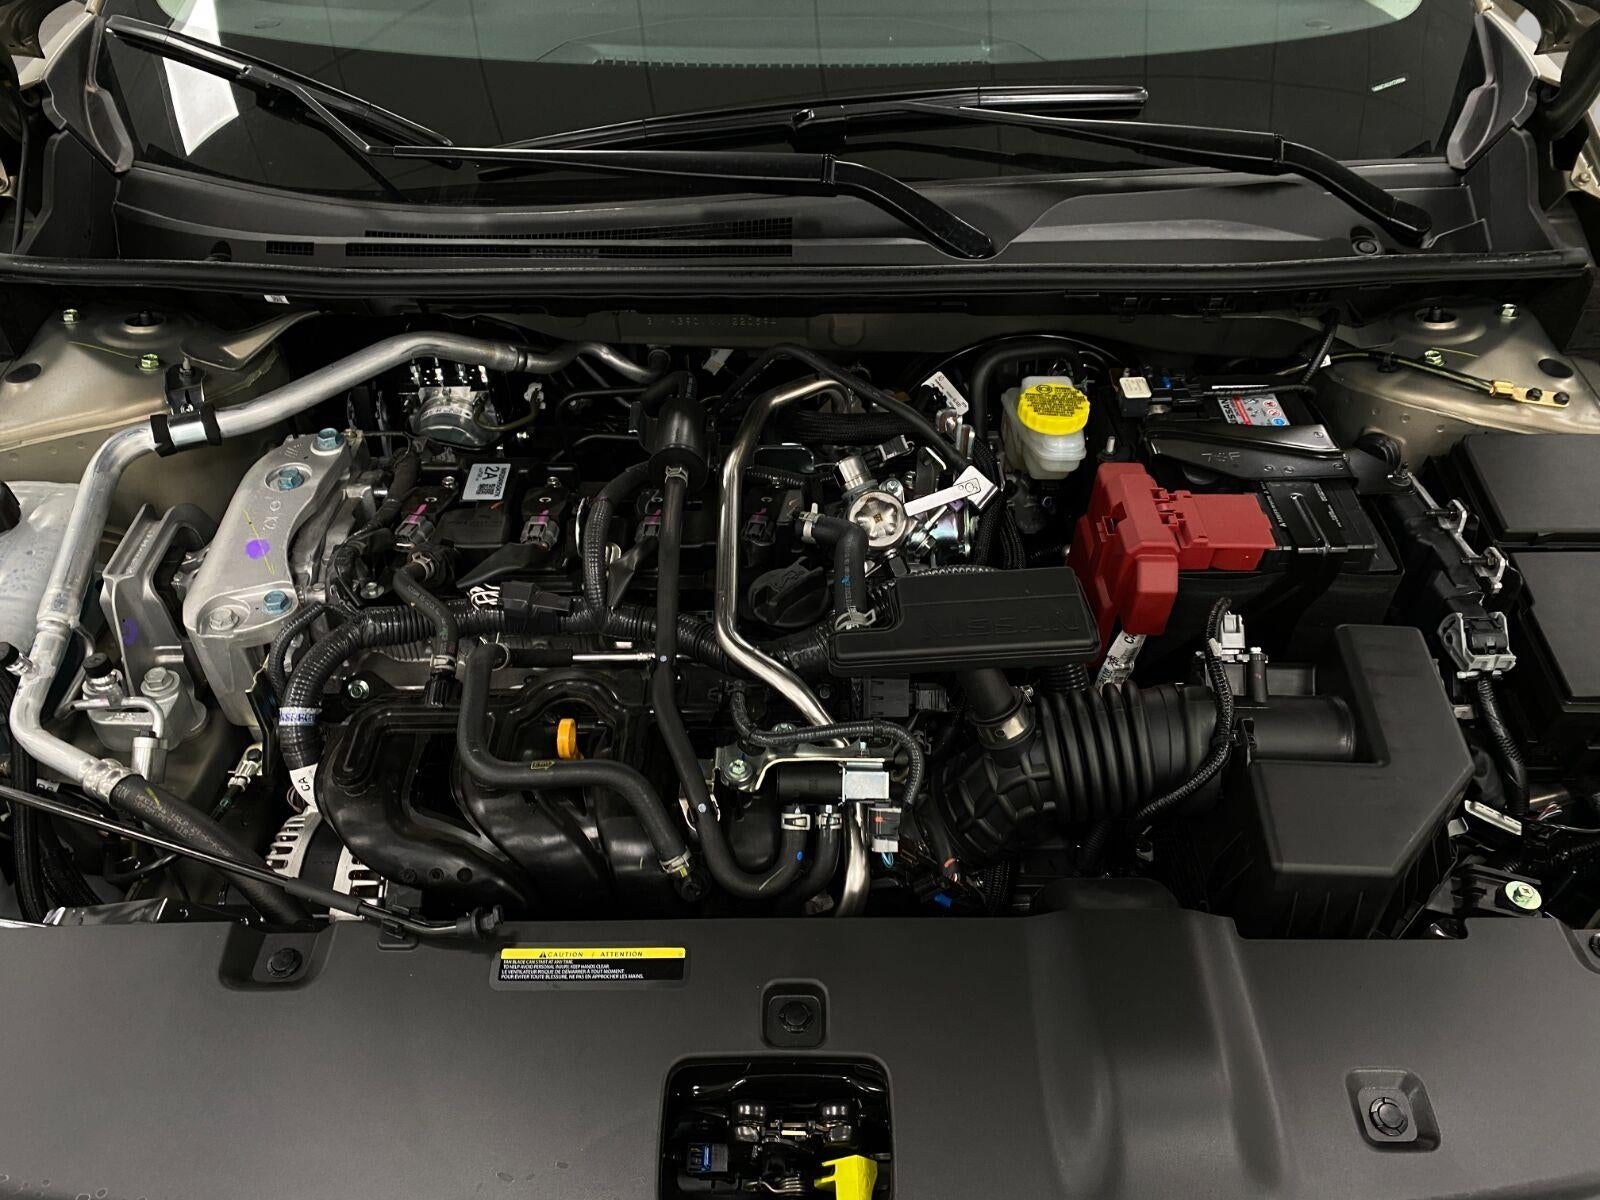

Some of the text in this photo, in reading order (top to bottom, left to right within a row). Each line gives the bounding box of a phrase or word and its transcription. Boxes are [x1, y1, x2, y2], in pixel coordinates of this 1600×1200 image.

[482, 466, 500, 480] 2A
[920, 615, 1081, 640] NISSAN
[298, 776, 311, 792] CA
